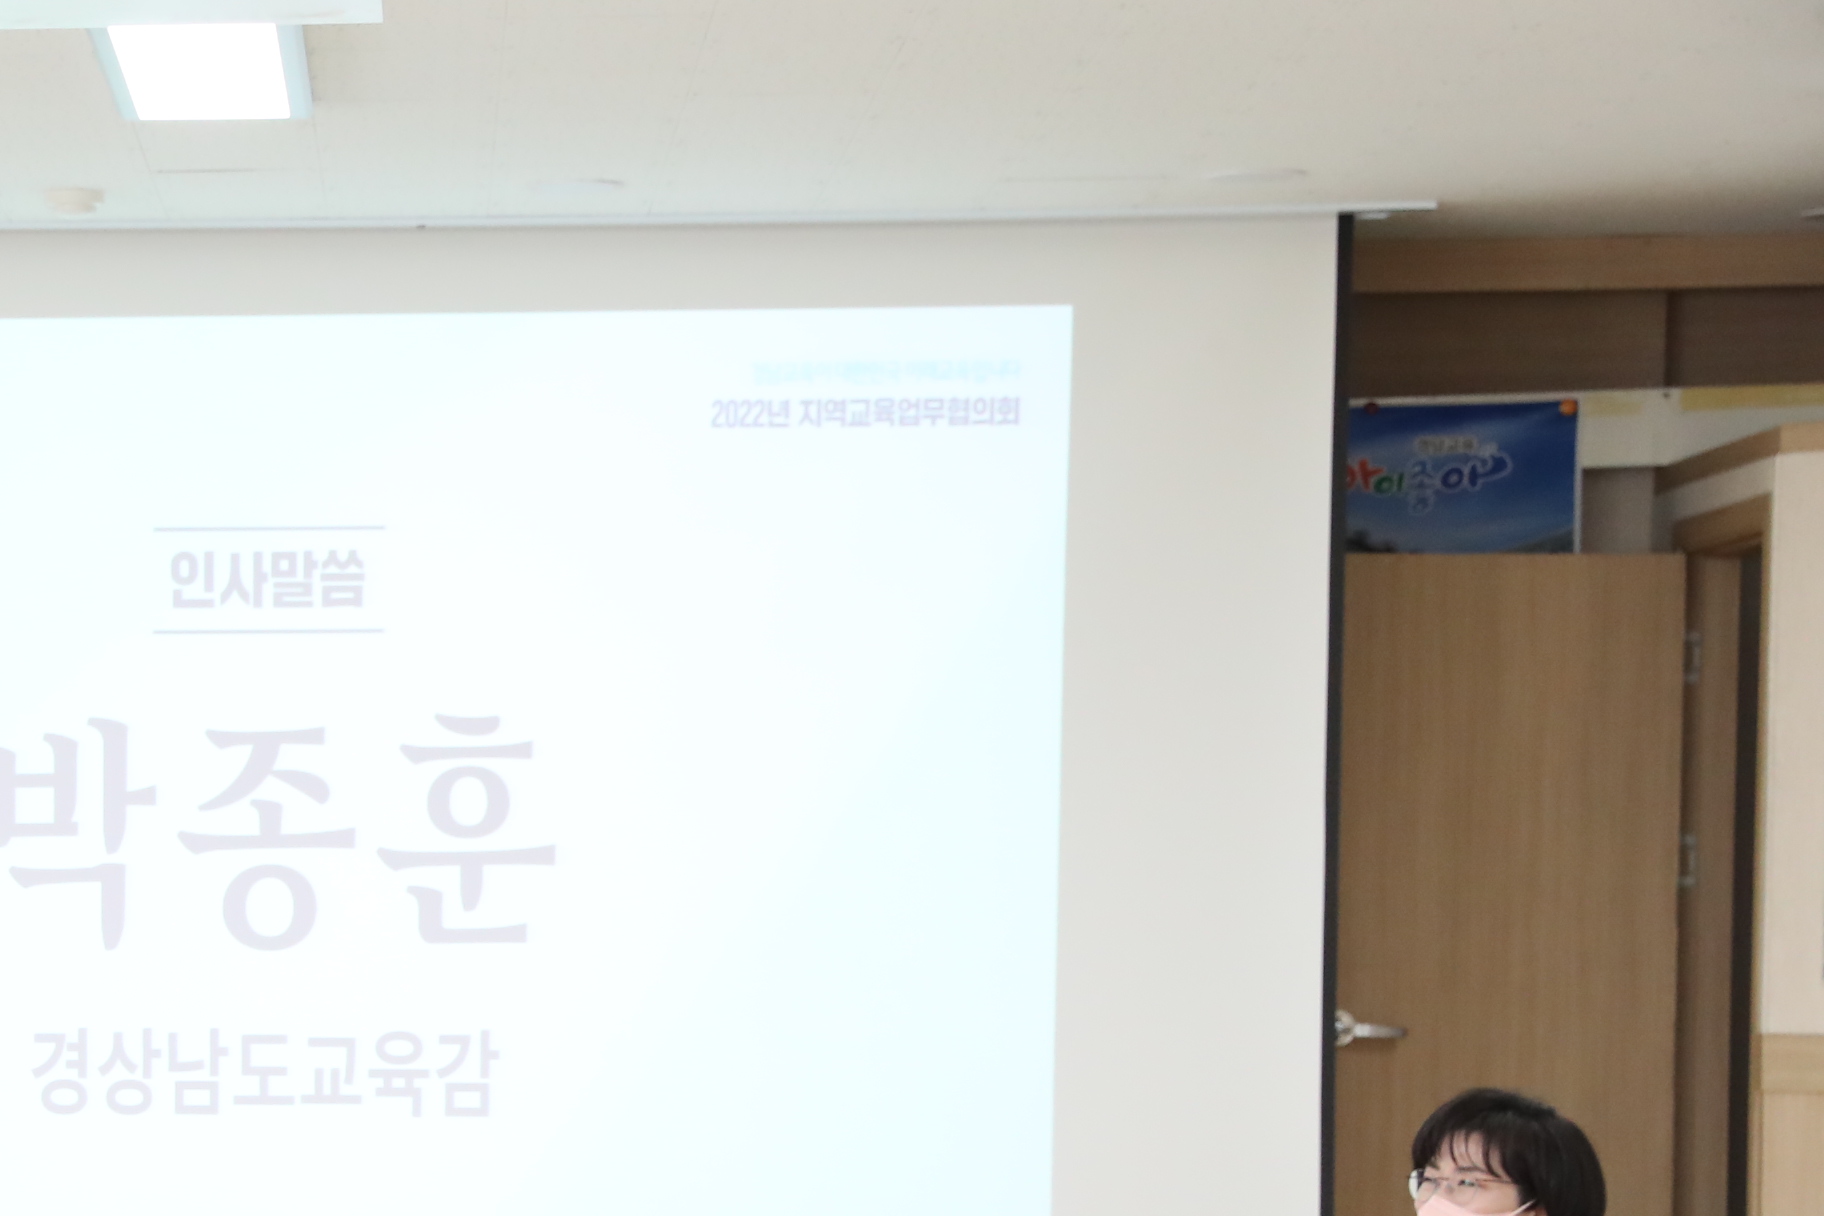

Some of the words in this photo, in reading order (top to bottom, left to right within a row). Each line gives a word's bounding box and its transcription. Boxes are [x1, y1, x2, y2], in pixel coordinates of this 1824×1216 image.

[711, 398, 791, 429] 2022년
[798, 395, 1022, 428] 지역교육업무협의회
[170, 549, 366, 609] 인사말씀
[31, 1027, 501, 1119] 경상남도교육감
